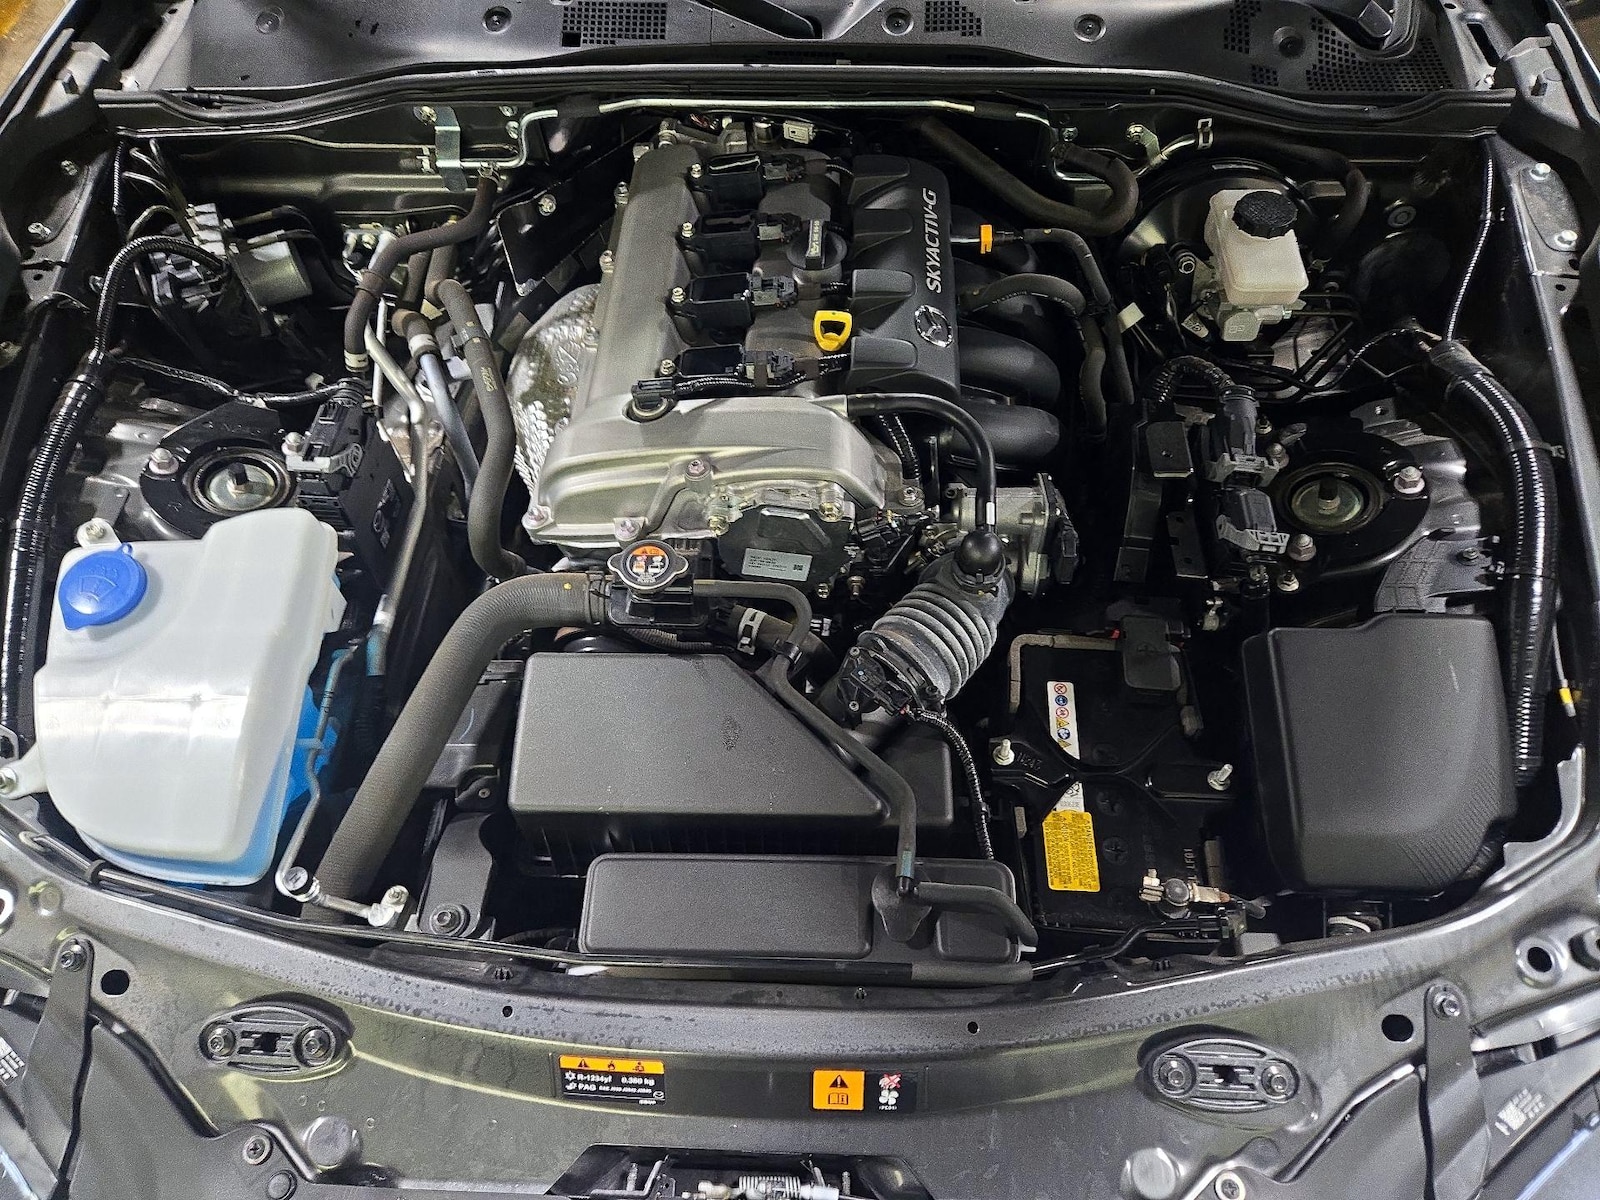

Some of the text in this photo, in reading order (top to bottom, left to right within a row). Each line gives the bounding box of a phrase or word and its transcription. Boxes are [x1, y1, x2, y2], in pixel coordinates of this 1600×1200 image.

[922, 187, 942, 294] SKYACTIV-G
[577, 1073, 613, 1084] R-1234yf
[578, 1083, 597, 1092] PAG
